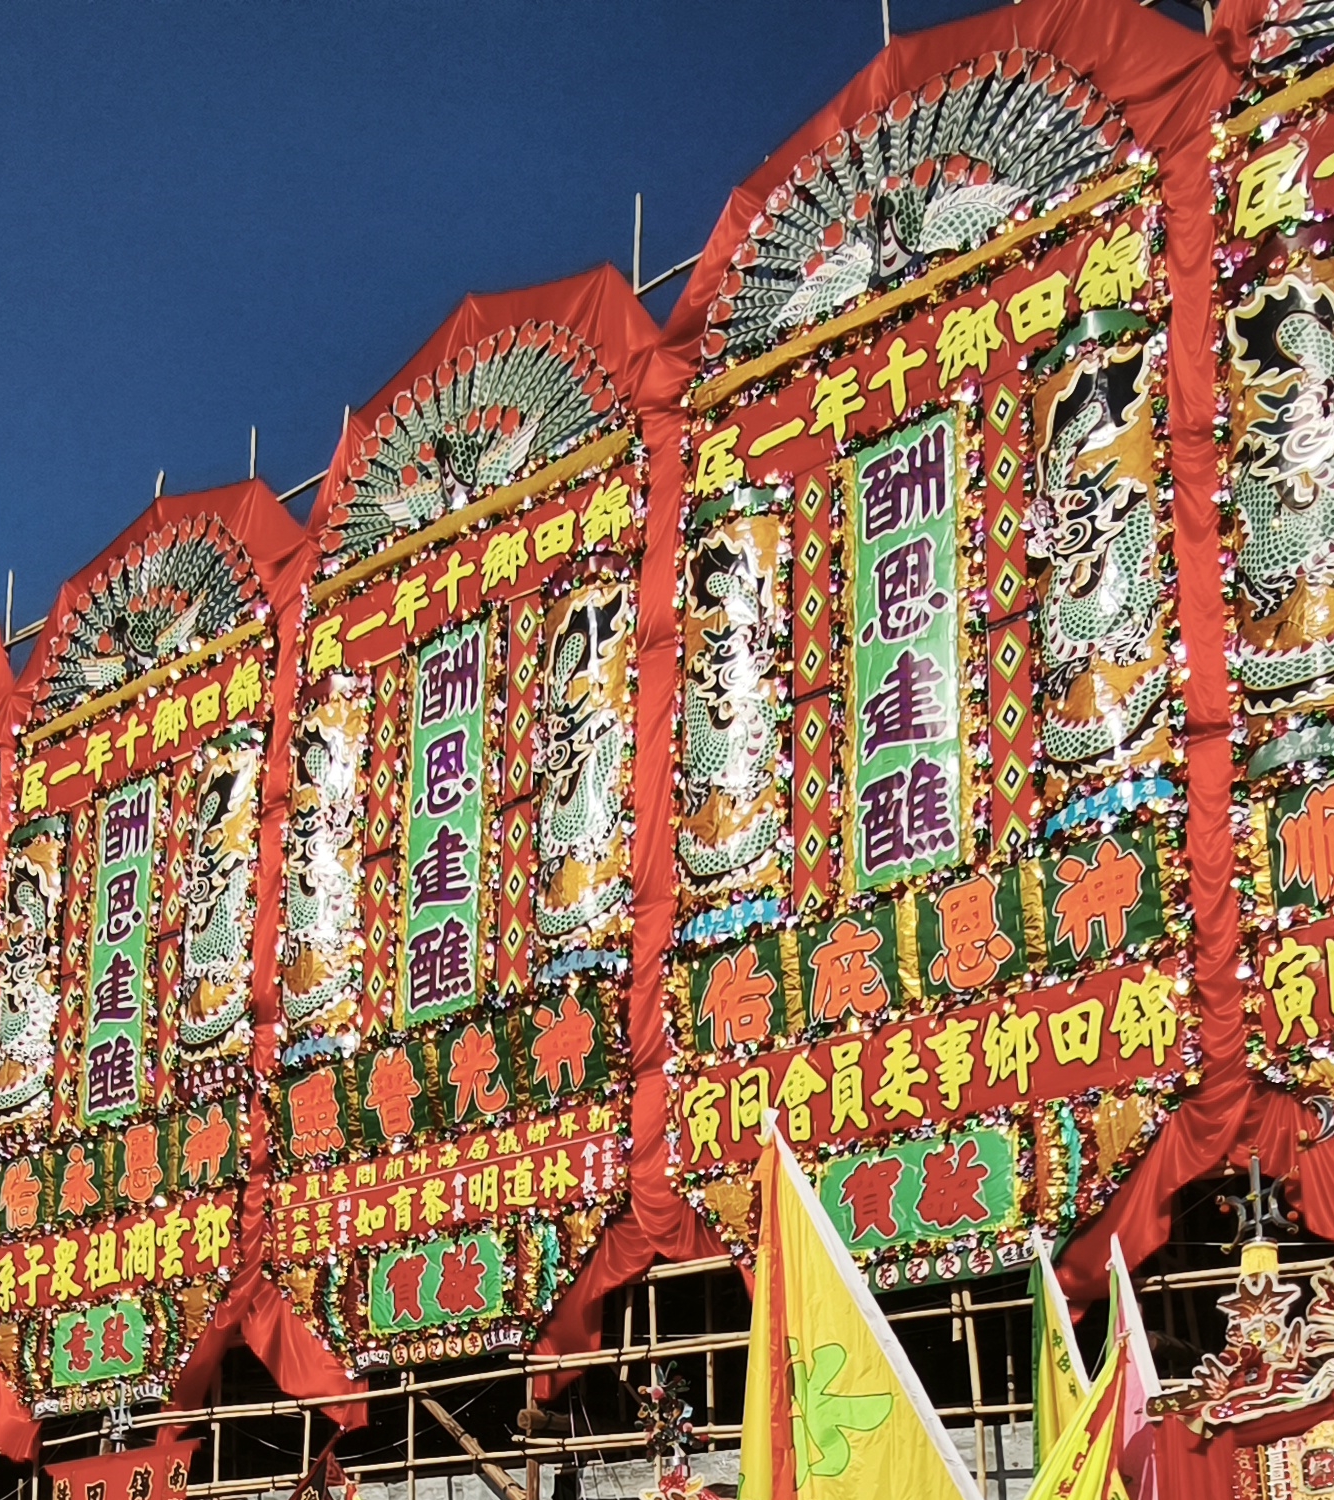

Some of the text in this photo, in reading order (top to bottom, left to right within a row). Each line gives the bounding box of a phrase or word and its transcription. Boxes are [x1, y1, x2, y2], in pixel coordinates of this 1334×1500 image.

[860, 422, 957, 874] 酬恩建醮
[409, 630, 487, 1013] 酬恩建醮
[87, 787, 155, 1115] 酬恩建醮
[289, 994, 597, 1157] 神光普照
[468, 1149, 578, 1213] 林道明
[840, 1138, 993, 1242] 敬賀
